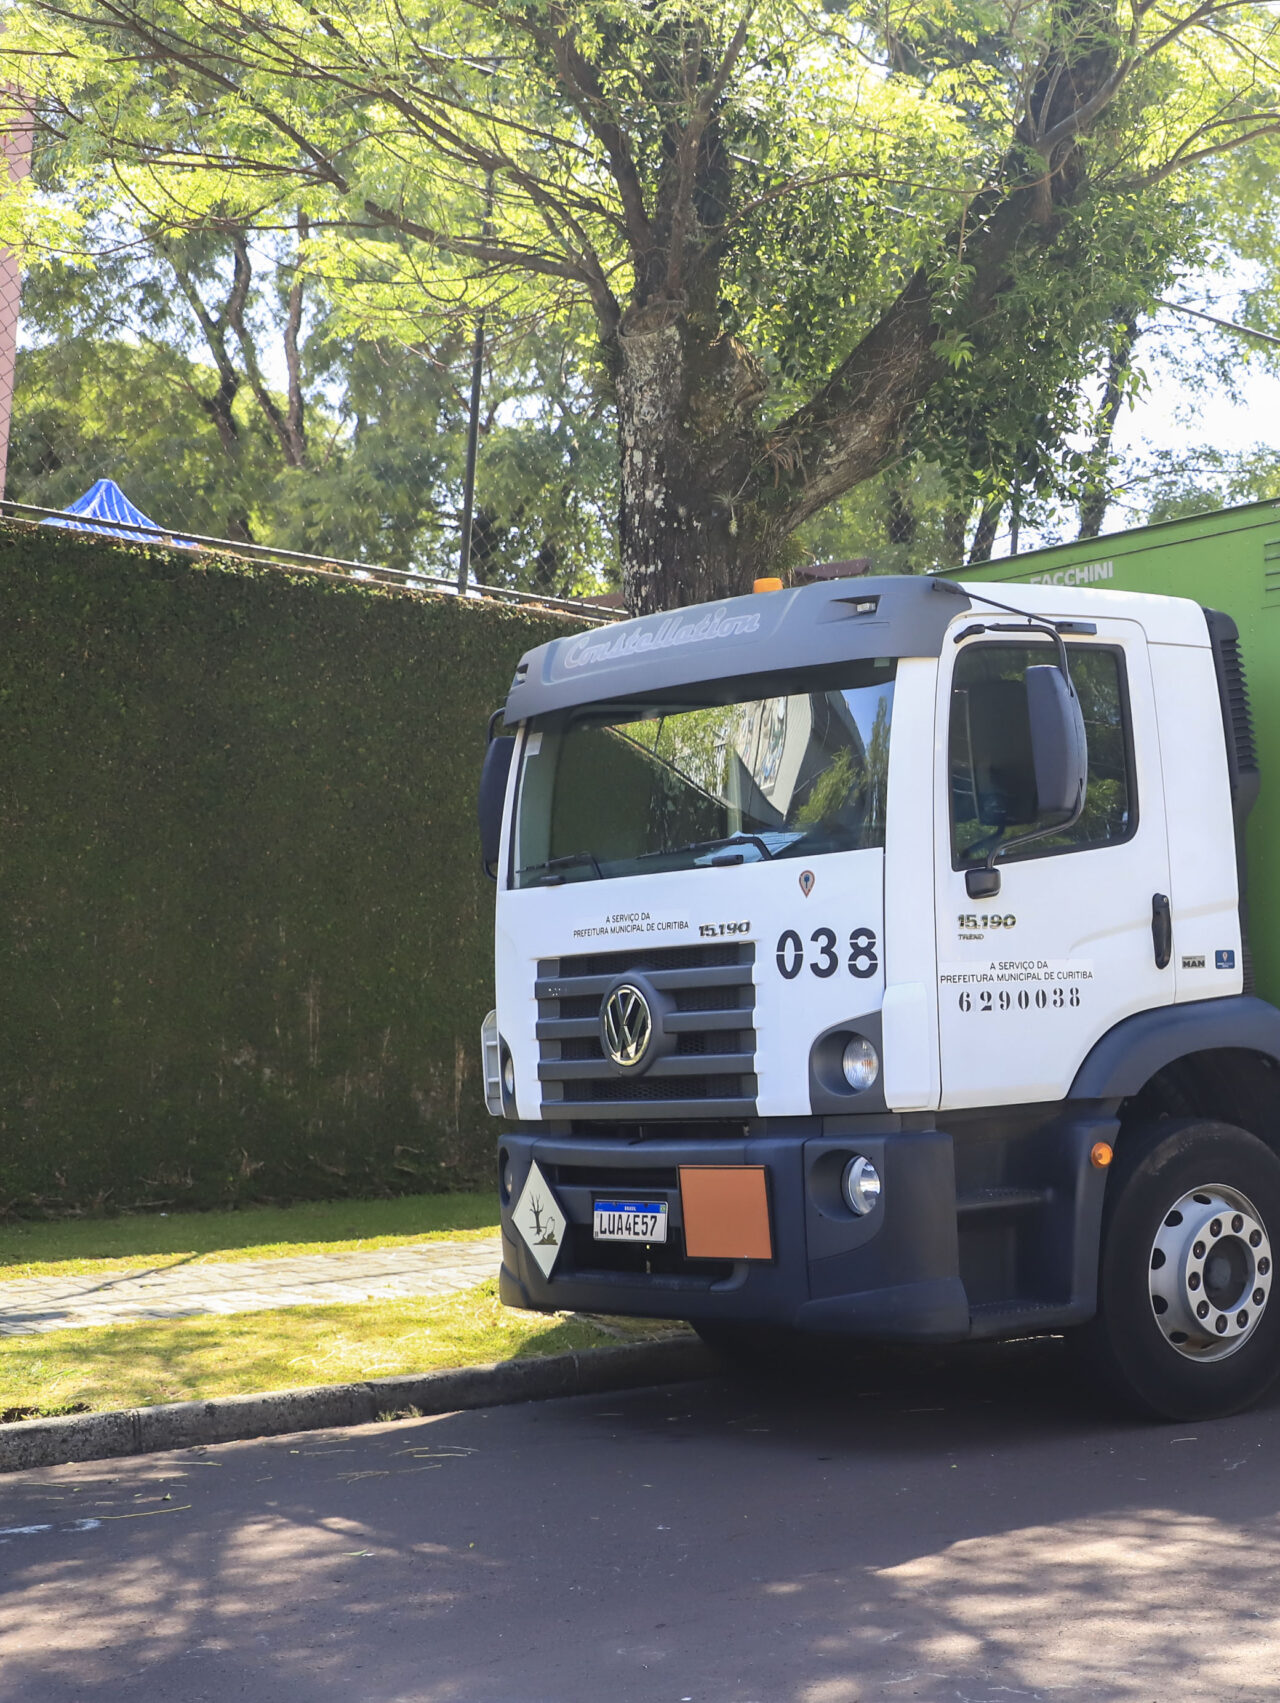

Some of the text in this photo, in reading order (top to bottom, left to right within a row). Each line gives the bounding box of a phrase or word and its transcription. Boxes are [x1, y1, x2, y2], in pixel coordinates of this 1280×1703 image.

[564, 606, 761, 668] Constellation
[605, 912, 650, 924] A SERVIÇO DA
[958, 913, 1017, 929] 15.190
[573, 921, 689, 938] PREFEITURA MUNICIPAL DE CURITIBA
[698, 920, 750, 937] 15.190
[776, 927, 878, 980] 038
[989, 960, 1048, 972] A SERVIÇO DA
[1182, 960, 1205, 968] MAN
[940, 970, 1093, 984] PREFEITURA MUNICIPAL DE CURITIBA
[959, 986, 1081, 1013] 6290038
[599, 1213, 658, 1237] LUA4E57
